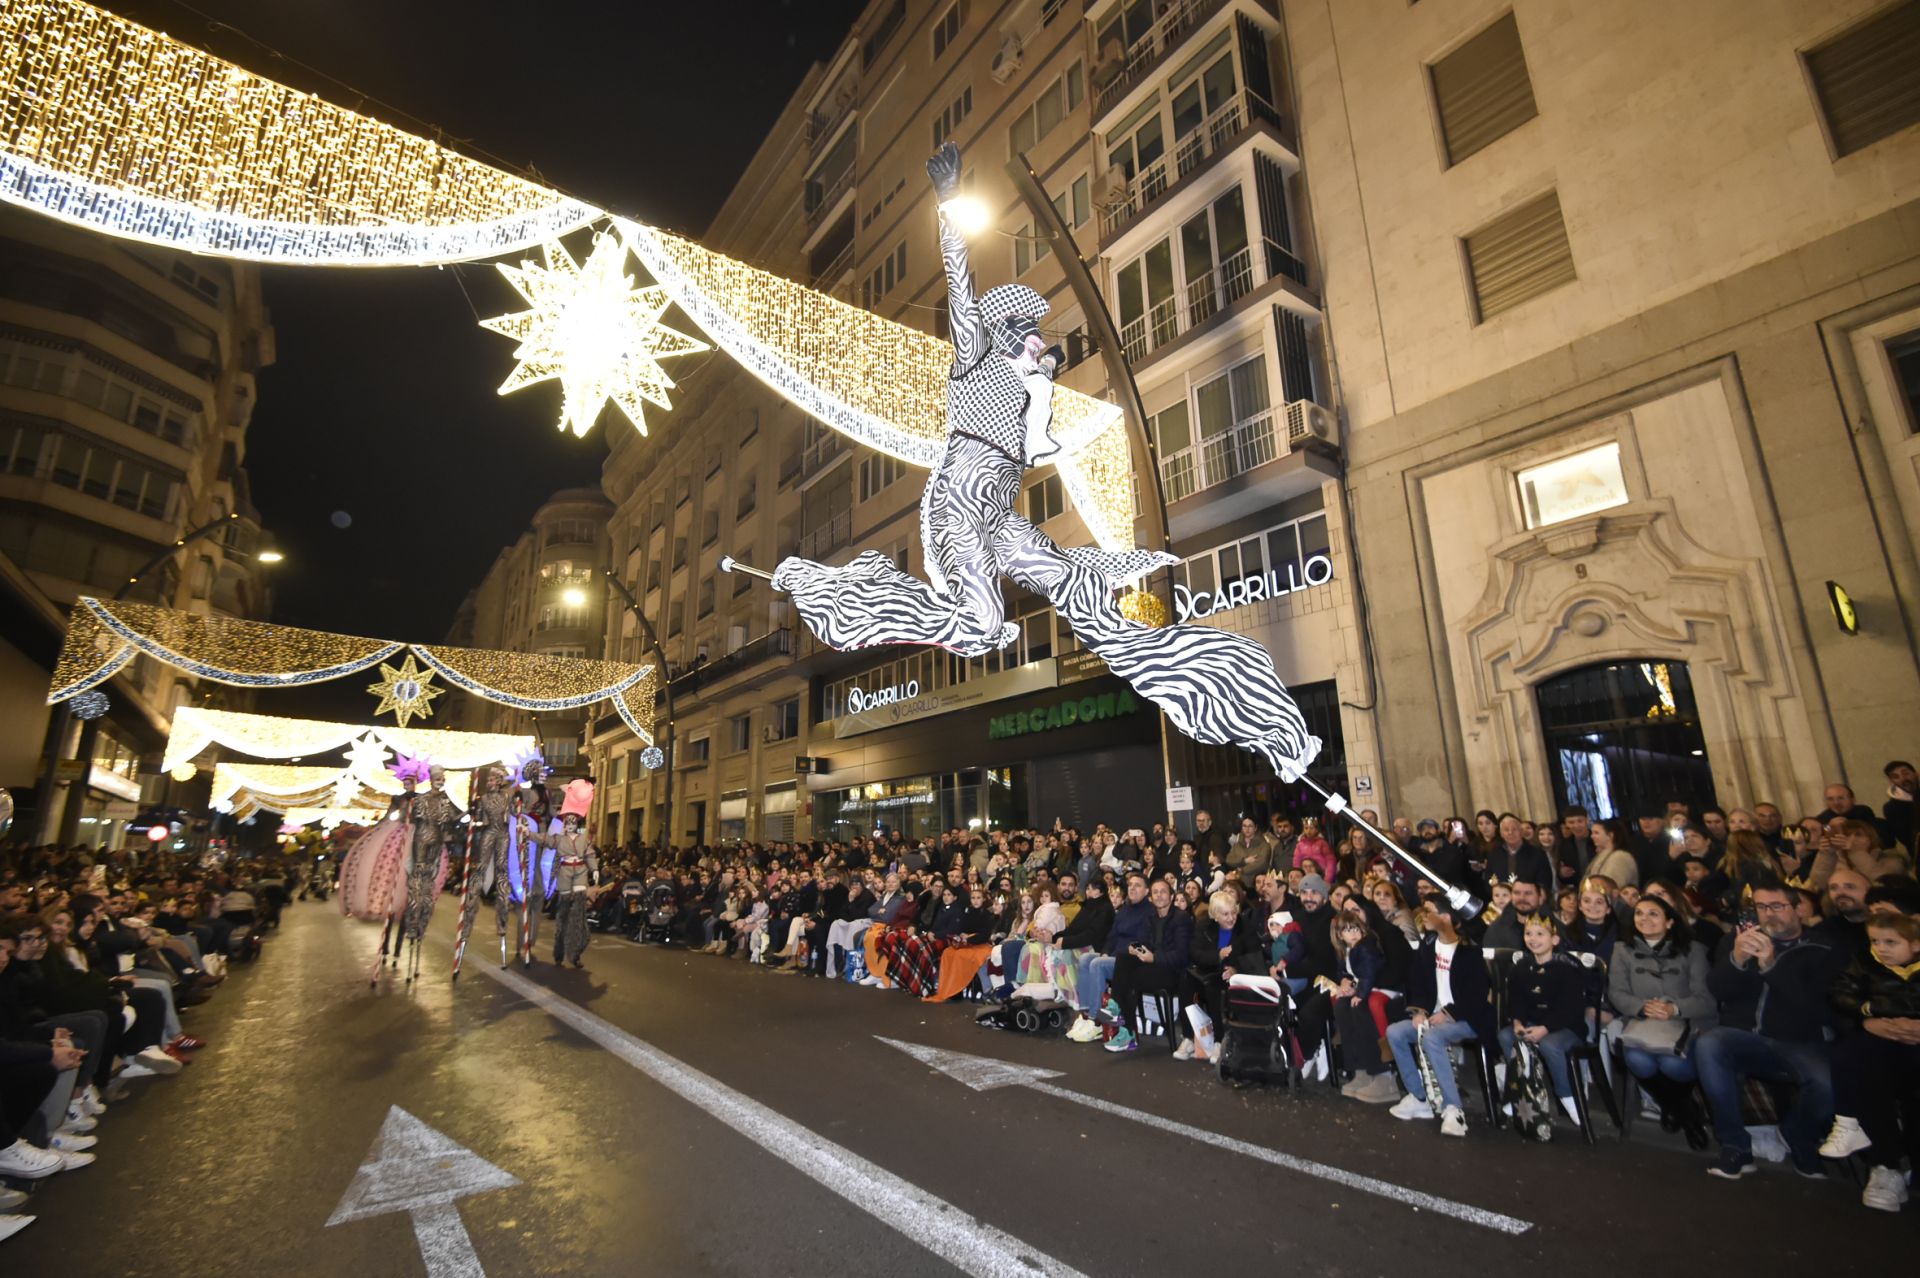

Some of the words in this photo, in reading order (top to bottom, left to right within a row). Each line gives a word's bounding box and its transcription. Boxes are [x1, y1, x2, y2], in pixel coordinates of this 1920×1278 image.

[1192, 555, 1333, 619] CARRILLO
[1575, 563, 1588, 580] 9
[863, 679, 919, 711] CARRILLO
[901, 696, 940, 717] CARRILLO
[989, 688, 1137, 740] MERCADONA
